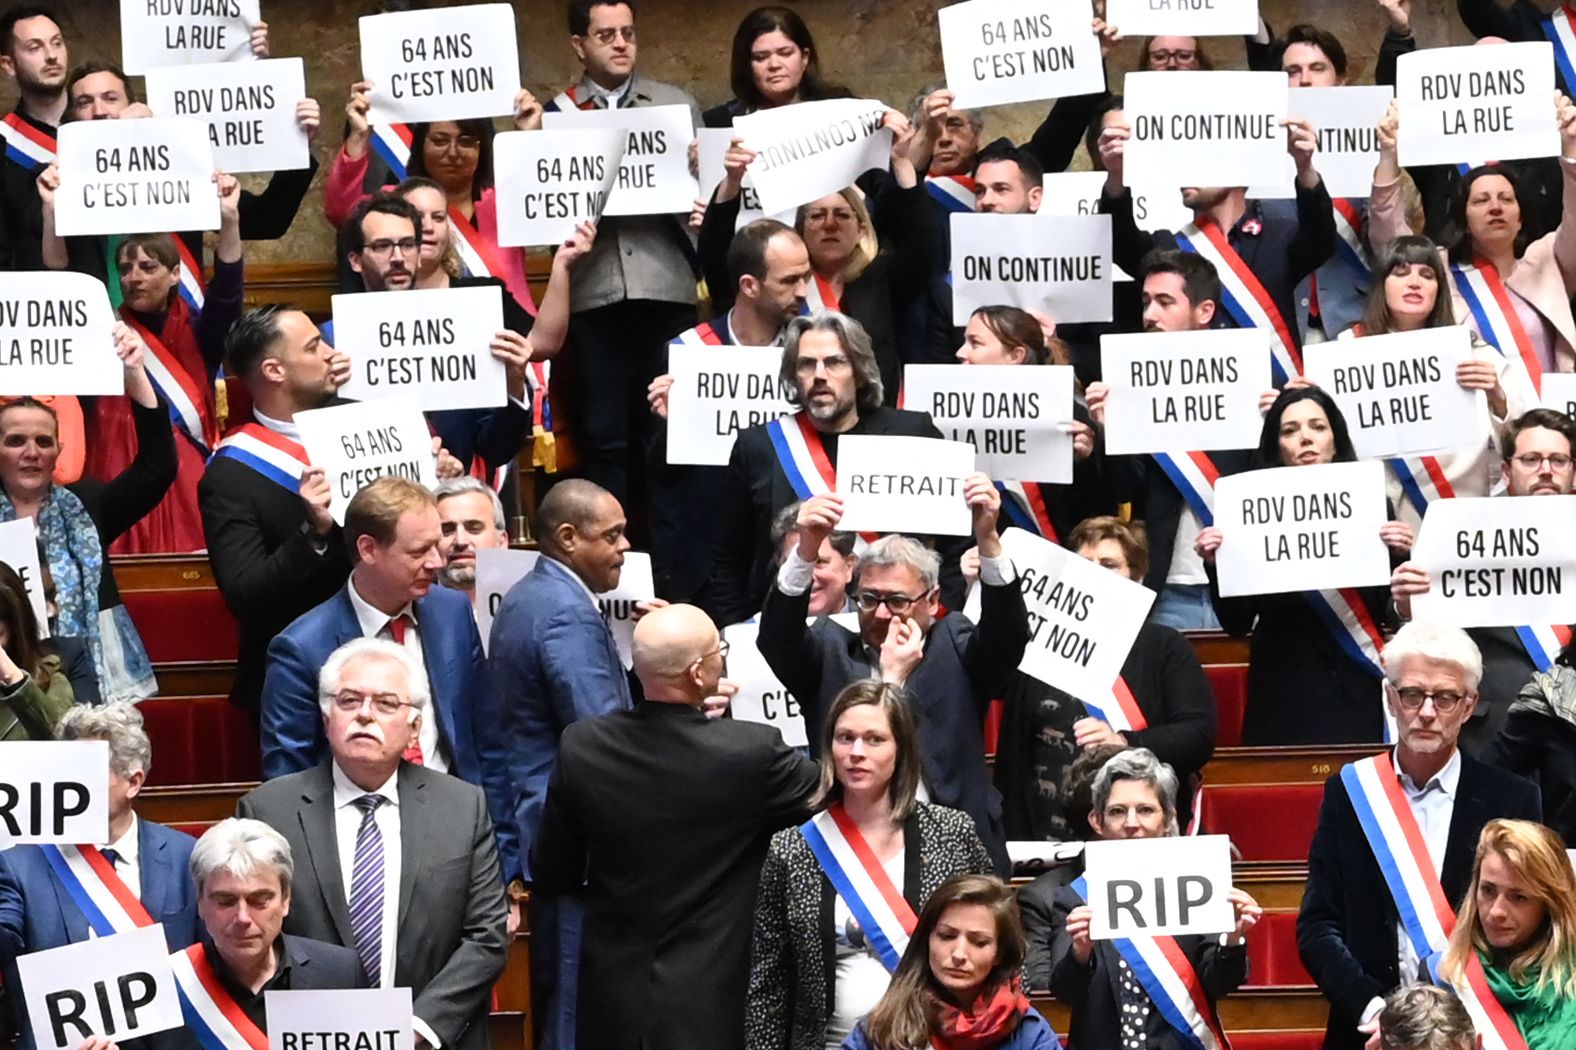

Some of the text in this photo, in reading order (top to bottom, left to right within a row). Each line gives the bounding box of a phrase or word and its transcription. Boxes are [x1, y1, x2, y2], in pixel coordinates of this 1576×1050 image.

[147, 0, 240, 18] RDV DANS
[166, 25, 227, 49] LA RUE
[982, 14, 1052, 45] 64 ANS
[402, 33, 472, 63] 64 ANS
[974, 46, 1074, 80] C'EST NON
[392, 67, 493, 98] C'EST NON
[1422, 69, 1524, 100] RDV DANS
[175, 85, 274, 115] RDV DANS
[209, 120, 264, 146] A RUE
[1136, 115, 1275, 140] ON CONTINUE
[1443, 106, 1513, 135] LA RUE
[623, 130, 667, 155] ANS
[96, 145, 169, 173] 64 ANS
[537, 156, 604, 183] 64 ANS
[84, 181, 189, 208] C'EST NON
[525, 192, 579, 219] C'EST
[964, 256, 1101, 282] ON CONTINUE
[28, 300, 87, 327] DANS
[380, 318, 454, 347] 64 ANS
[31, 339, 72, 365] RUE
[367, 355, 476, 385] C'EST NON
[1131, 357, 1238, 387] RDV DANS
[1334, 356, 1440, 394] RDV DANS
[698, 373, 739, 398] RDV
[934, 392, 1039, 419] RDV DANS
[1153, 395, 1225, 423] LA RUE
[1358, 395, 1432, 428] LA RUE
[717, 410, 740, 435] LA
[341, 426, 402, 459] 64 ANS
[985, 429, 1026, 454] RUE
[851, 475, 957, 496] RETRAIT
[1243, 492, 1352, 525] RDV DANS
[1265, 531, 1339, 561] LA RUE
[1457, 528, 1539, 558] 64 ANS
[1019, 568, 1093, 621] 64 ANS
[1442, 567, 1561, 598] C'EST NON
[1045, 624, 1096, 667] NON
[0, 782, 90, 836] RIP
[1107, 876, 1212, 929] RIP
[45, 971, 158, 1048] RIP
